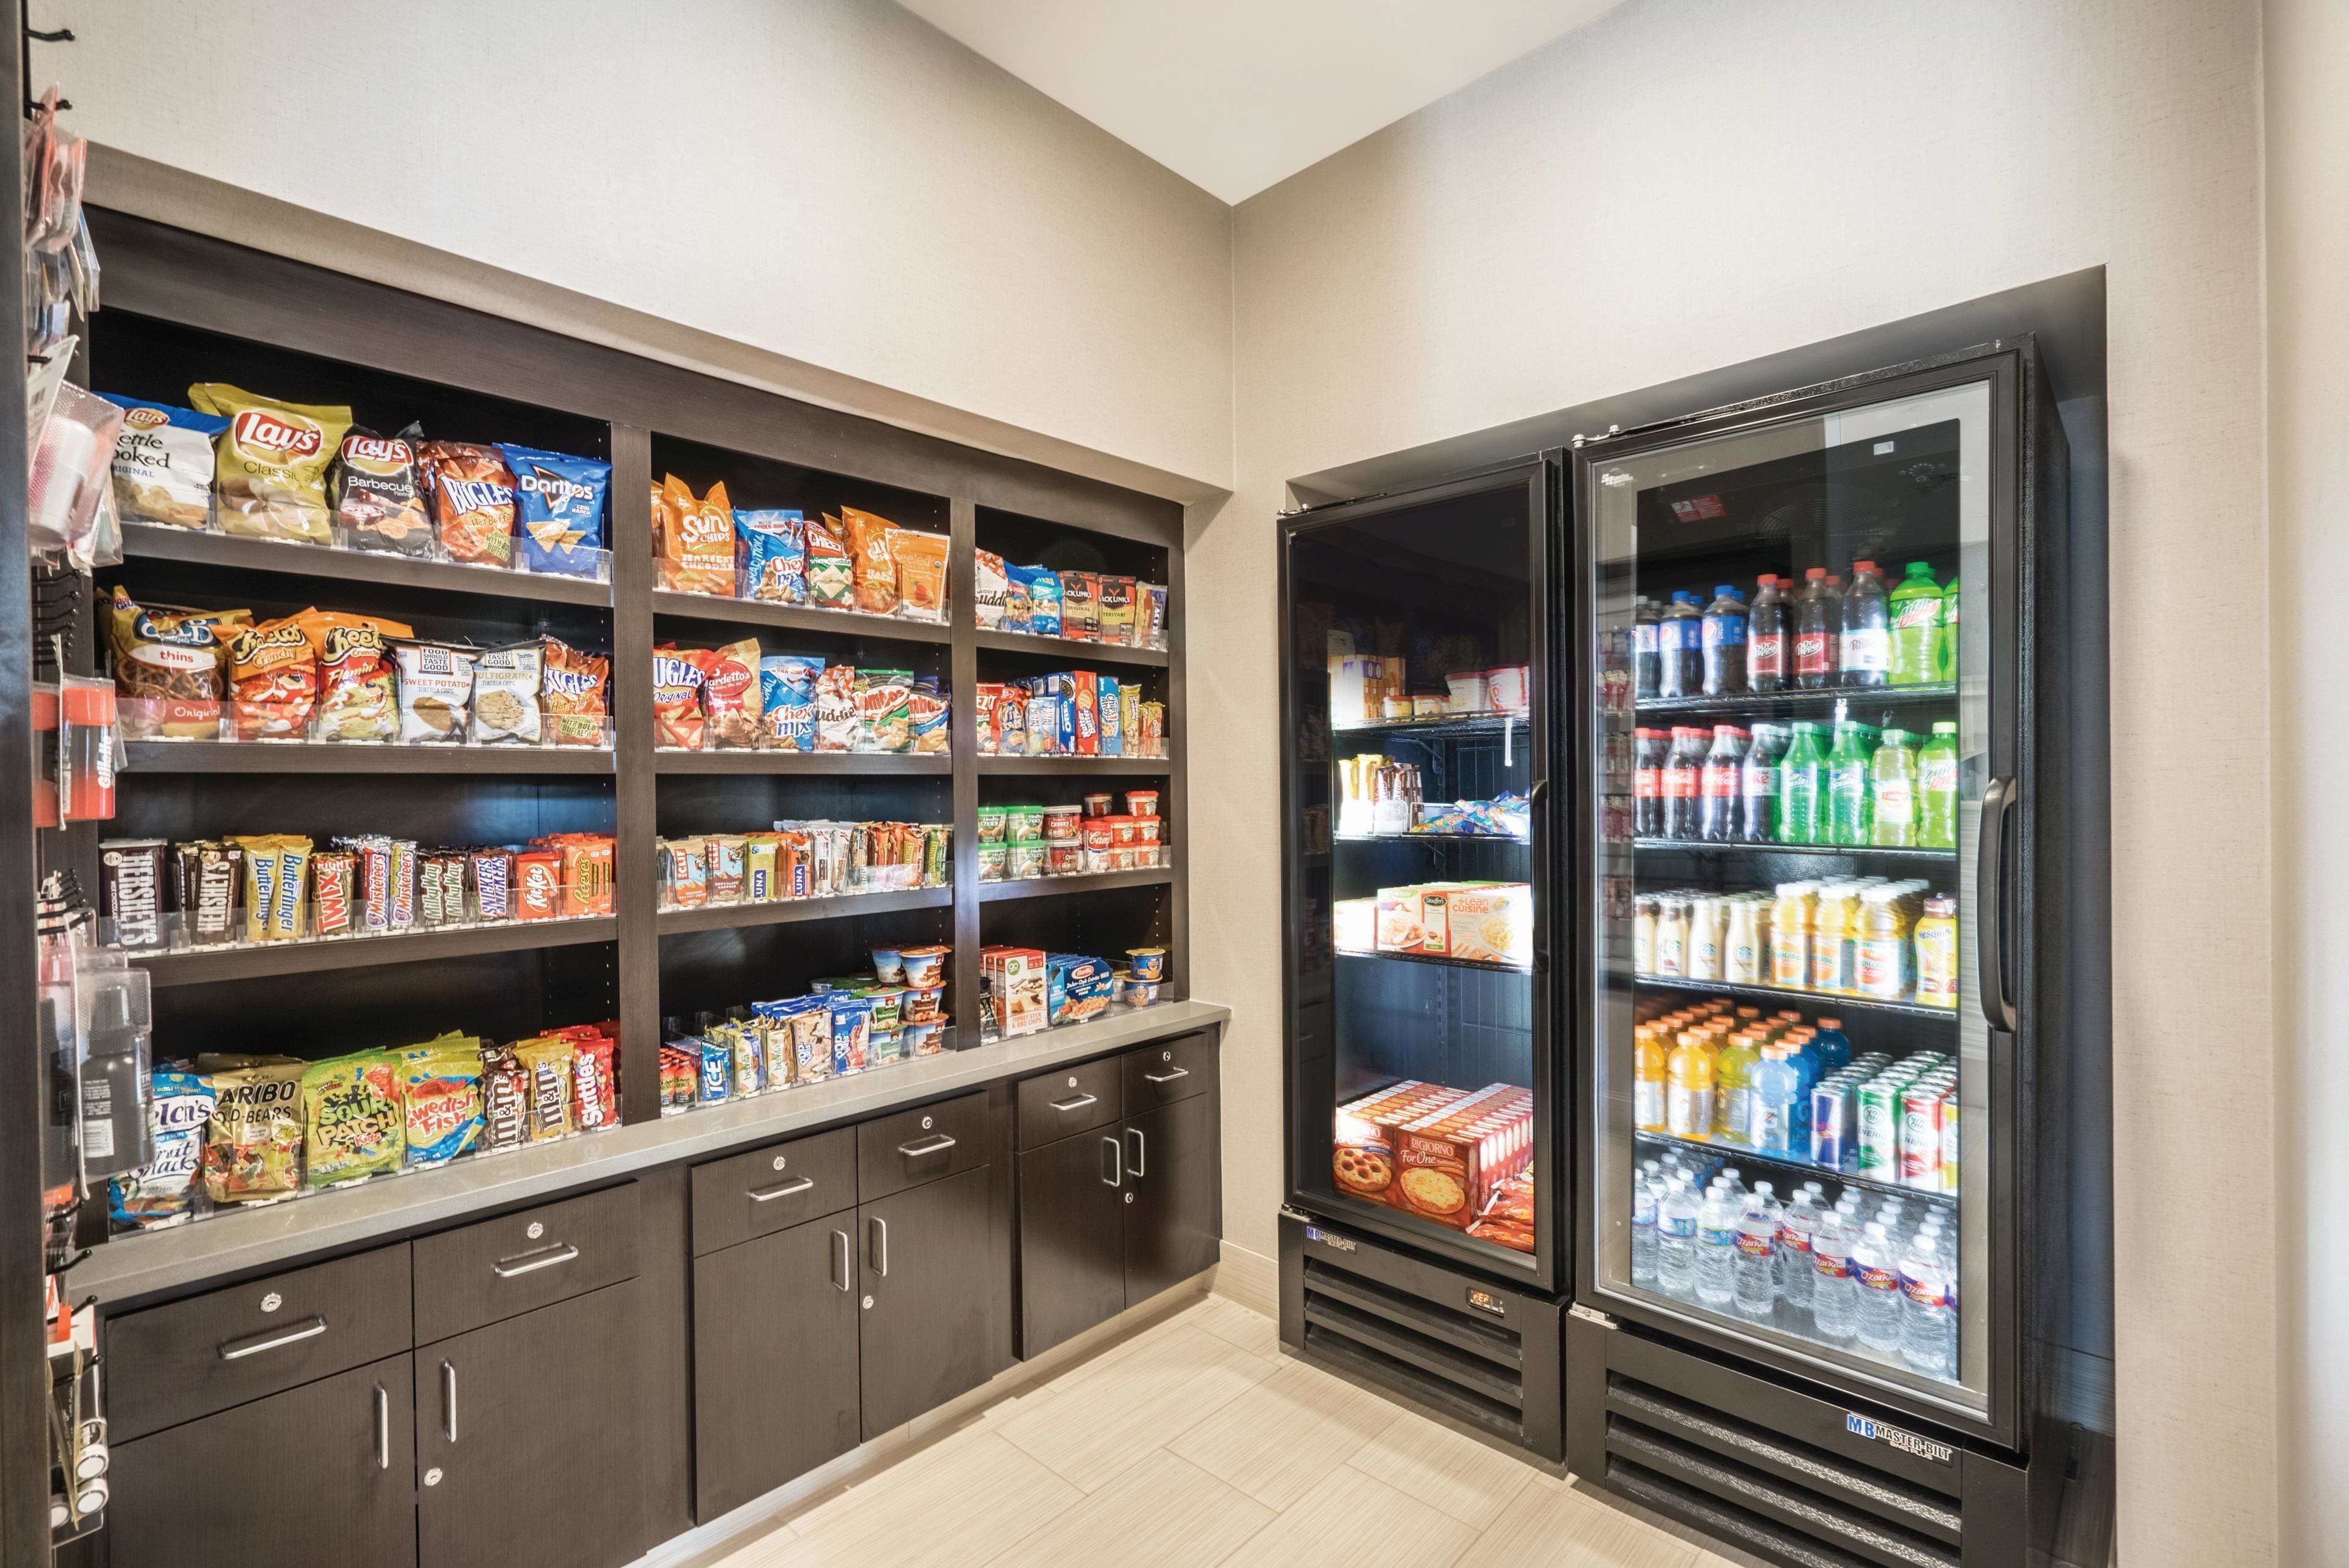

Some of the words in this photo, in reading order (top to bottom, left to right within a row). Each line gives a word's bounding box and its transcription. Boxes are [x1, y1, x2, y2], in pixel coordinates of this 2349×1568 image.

[240, 412, 320, 456] Lay's
[114, 447, 171, 469] oked
[347, 437, 407, 461] Lay's
[114, 465, 155, 478] RIGINAL
[347, 476, 412, 492] Barbecue
[439, 474, 514, 516] BUGLES
[521, 475, 593, 500] Doritos
[681, 515, 730, 543] Sun
[699, 532, 730, 543] CHIPS
[681, 554, 734, 563] HARVEST
[681, 562, 734, 571] CHEDDAR
[159, 650, 194, 664] thins
[251, 649, 296, 667] Crunchy
[653, 657, 705, 688] UGLES
[705, 671, 751, 687] ardetto's
[174, 706, 221, 721] Original
[772, 704, 813, 722] Chex
[577, 722, 596, 730] BOLD
[777, 722, 811, 738] mix
[97, 735, 113, 789] Gillette
[677, 850, 687, 874] CLIF
[276, 853, 303, 932] Butterfinger
[368, 852, 386, 918] Musketeers
[395, 851, 414, 912] Musketeers
[478, 858, 493, 916] SNICKERS
[755, 872, 764, 898] LUNA
[118, 854, 158, 946] HERSHEY'S
[197, 861, 230, 932] HERSHEY'S
[317, 870, 350, 933] TWIX
[1012, 1014, 1029, 1022] TURKEY
[1028, 1017, 1042, 1025] CHIPS
[576, 1052, 603, 1125] Skittles
[705, 1060, 724, 1092] ICE
[214, 1082, 296, 1107] ARIBO
[319, 1098, 388, 1125] SOUR
[406, 1091, 477, 1129] Swedish
[317, 1111, 396, 1146] PATCH
[419, 1112, 467, 1138] Fish
[157, 1141, 193, 1161] ruit
[1400, 1150, 1417, 1163] For
[1417, 1150, 1436, 1164] One
[1321, 1231, 1356, 1250] MASTER-BILT
[1876, 1425, 1951, 1461] MASTER-BILT
[1910, 1447, 1934, 1460] PLUS
